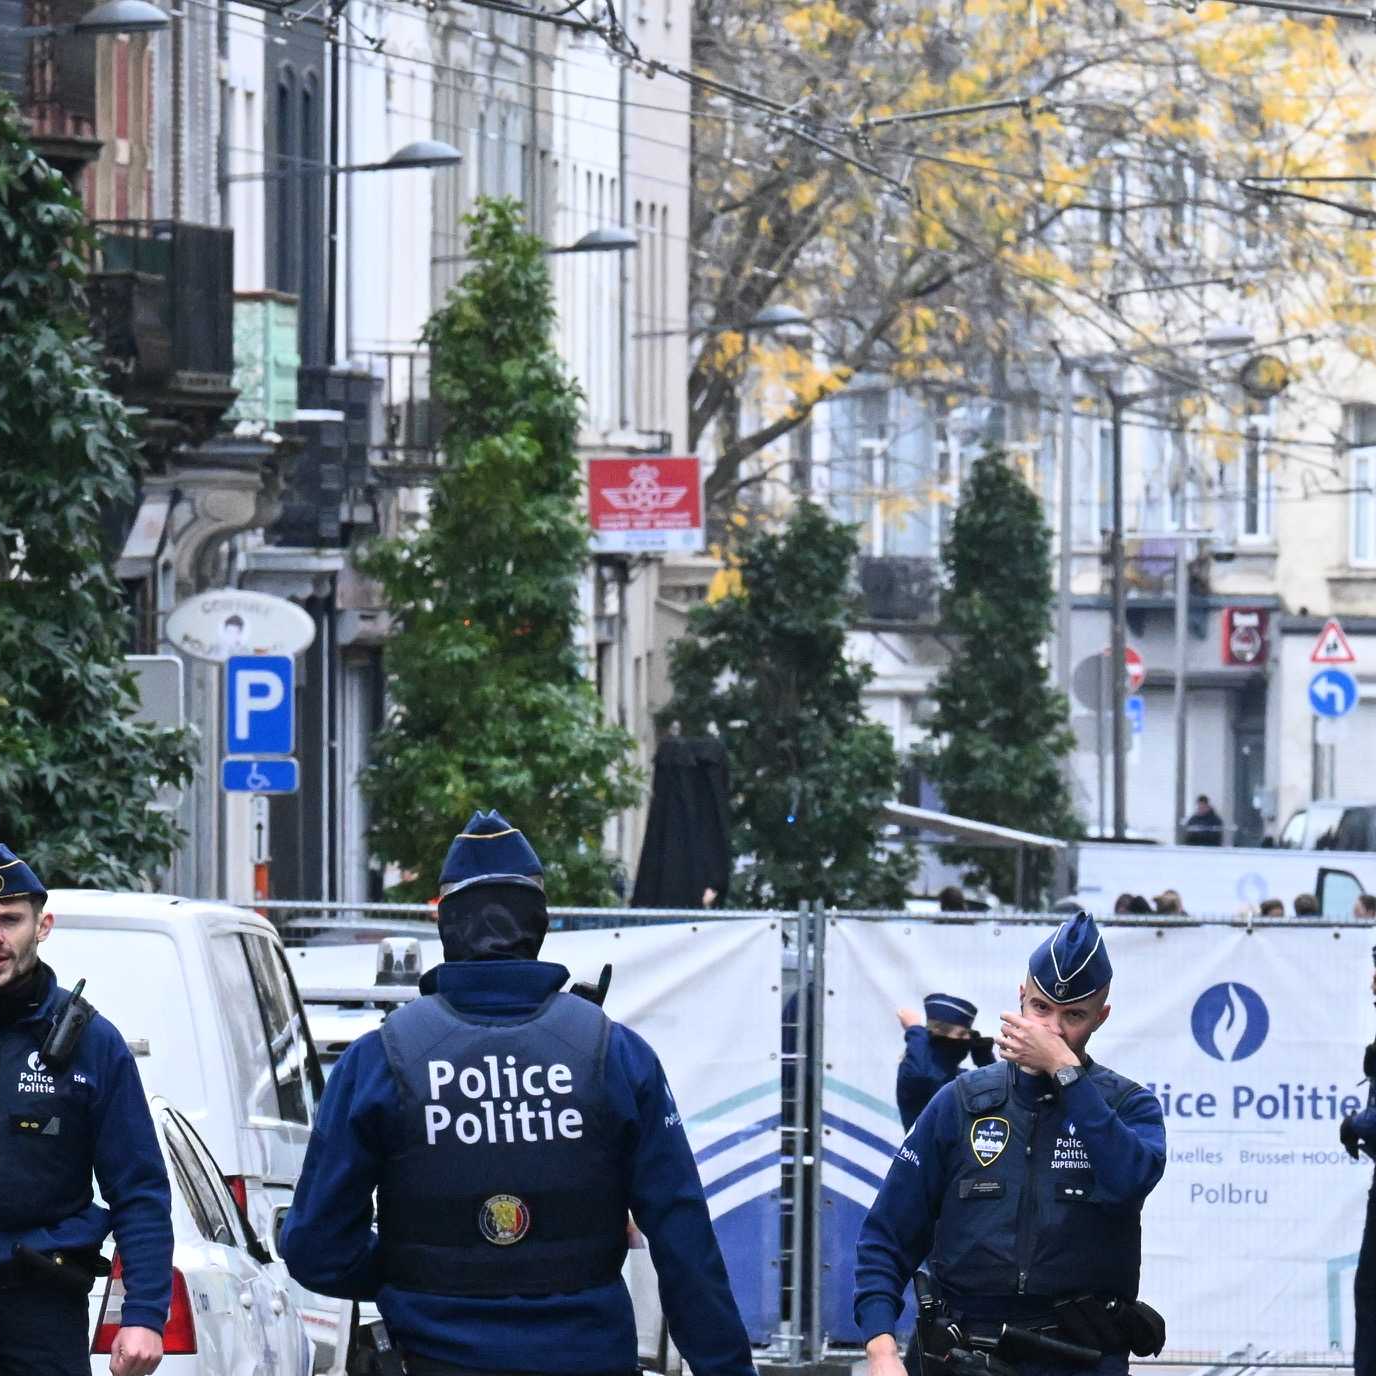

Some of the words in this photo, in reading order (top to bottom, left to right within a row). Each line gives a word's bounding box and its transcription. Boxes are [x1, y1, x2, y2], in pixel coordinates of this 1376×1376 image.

[235, 669, 284, 741] P
[20, 1072, 54, 1083] Police
[428, 1055, 573, 1101] Police
[18, 1083, 55, 1093] Politie
[1233, 1083, 1361, 1120] Politie
[425, 1098, 584, 1146] Politie
[1056, 1138, 1082, 1148] Polic
[1051, 1160, 1091, 1169] SUPERVISO
[1170, 1148, 1223, 1164] Ixelles
[1239, 1149, 1295, 1165] Brussel
[1191, 1182, 1268, 1204] Polbru
